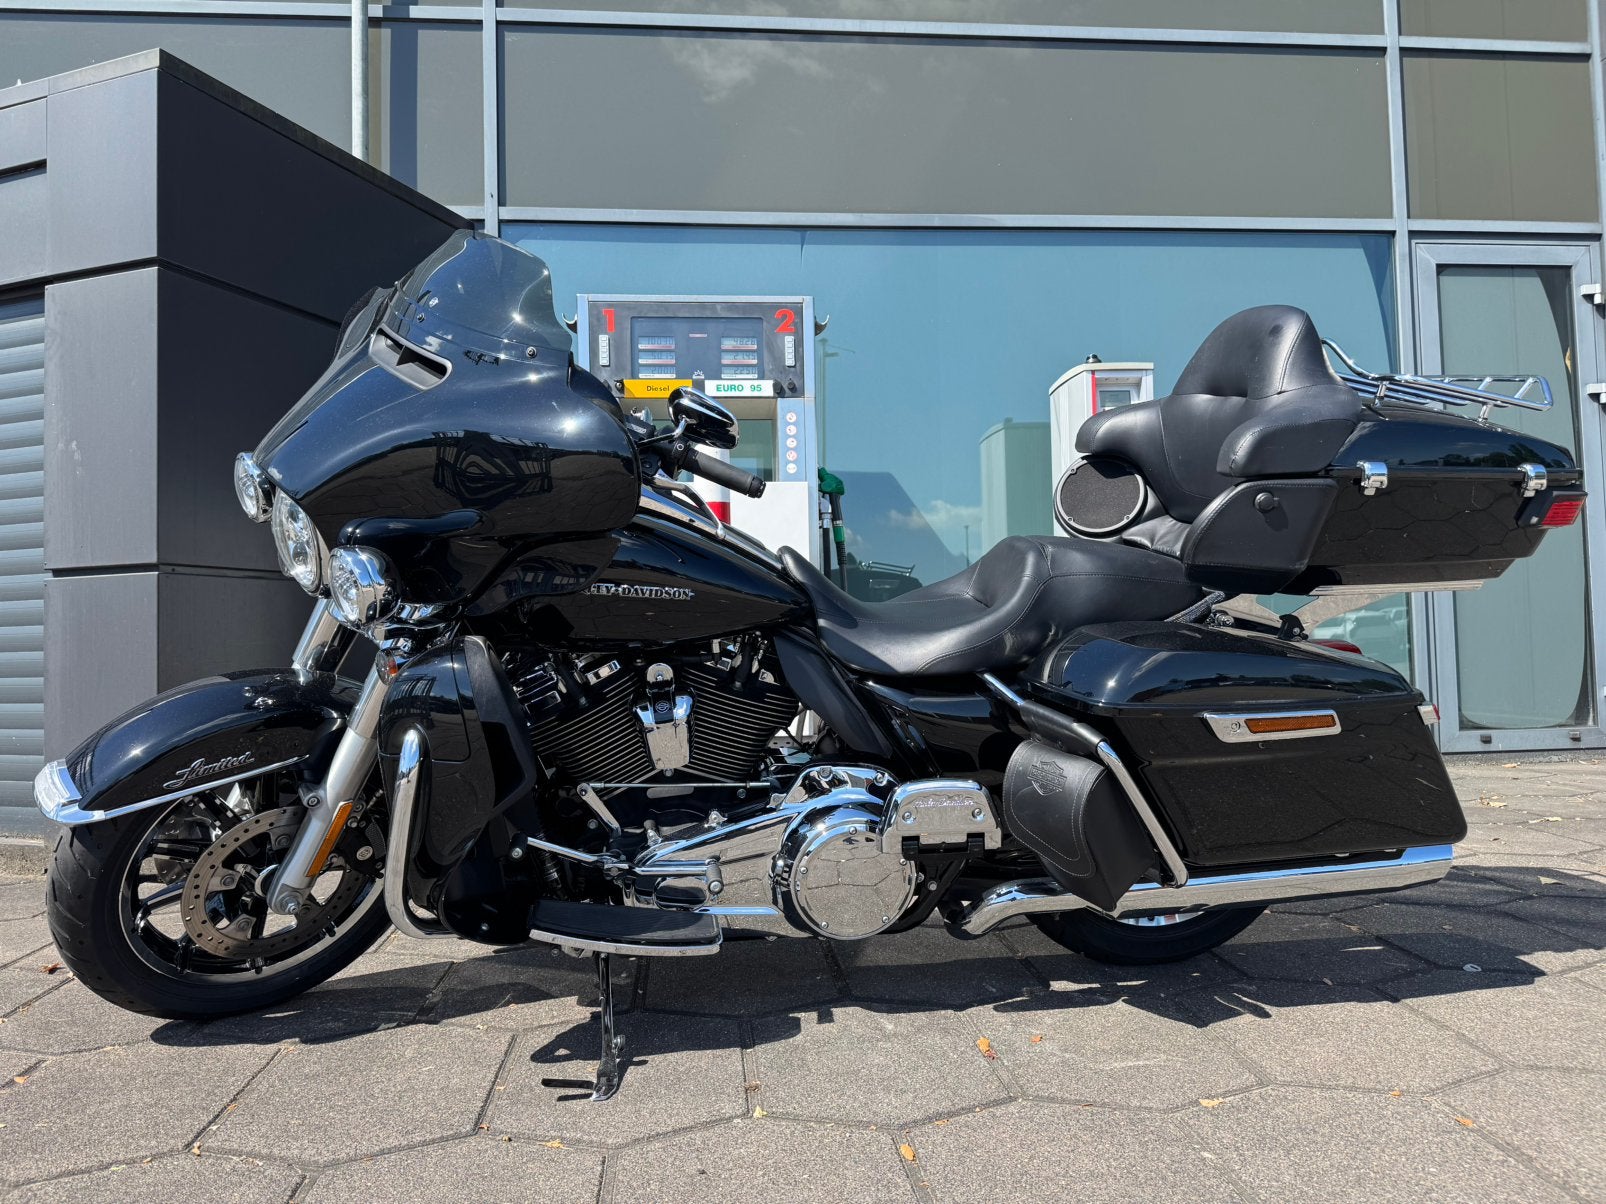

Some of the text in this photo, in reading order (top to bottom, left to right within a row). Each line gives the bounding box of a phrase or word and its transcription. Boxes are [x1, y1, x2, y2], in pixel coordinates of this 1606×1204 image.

[602, 308, 615, 333] 1
[774, 308, 795, 333] 2
[716, 384, 762, 392] EURO 95
[162, 751, 255, 790] Limited
